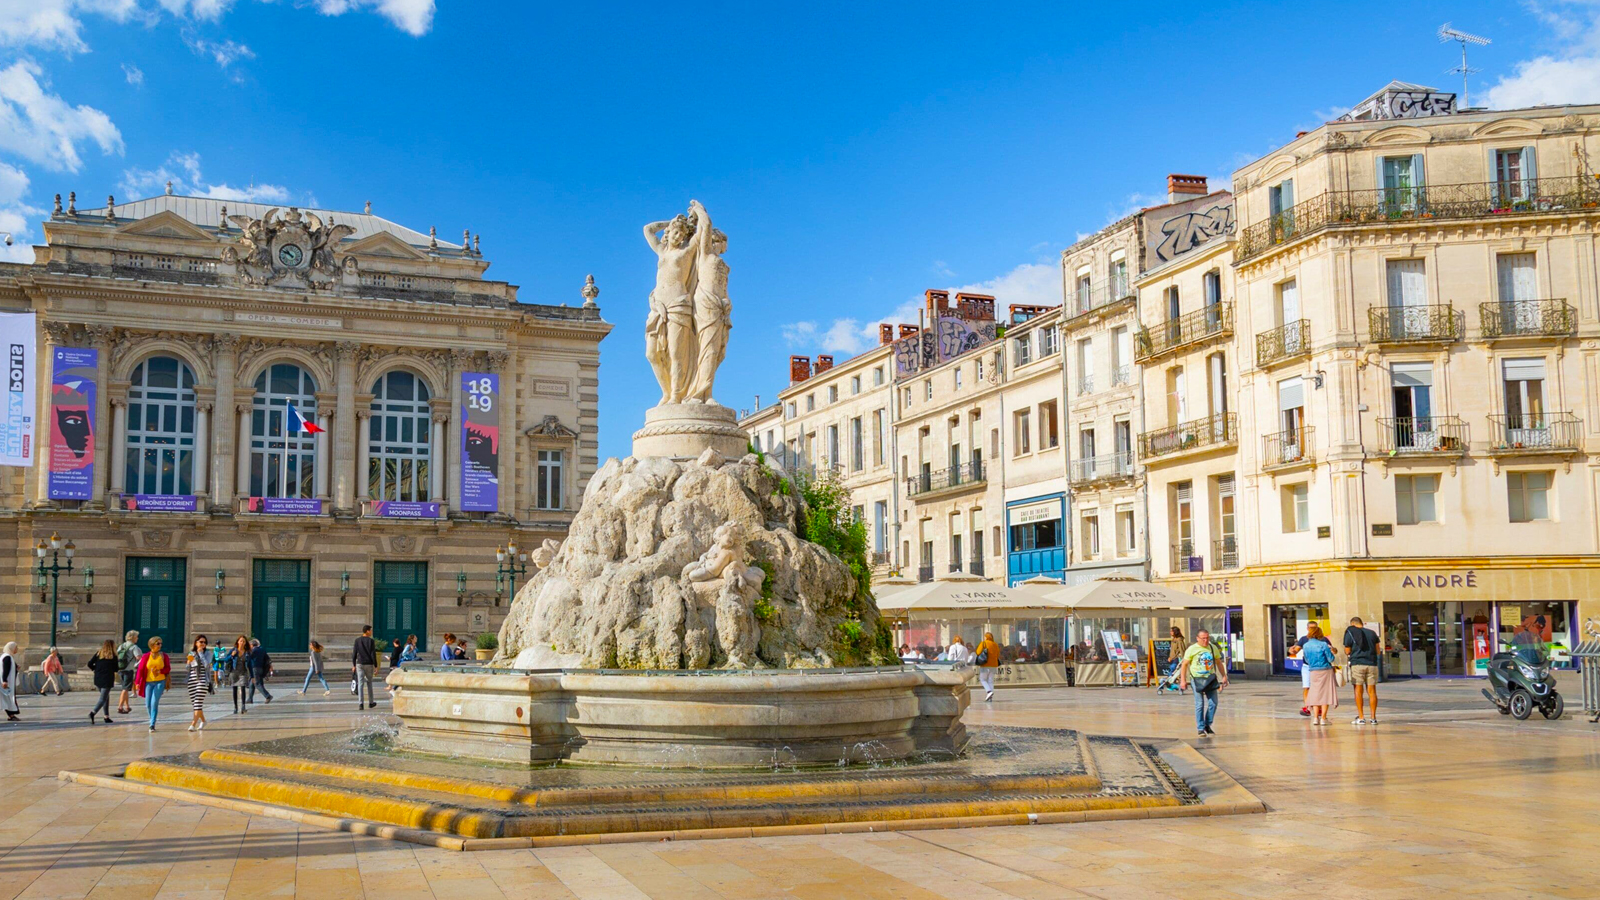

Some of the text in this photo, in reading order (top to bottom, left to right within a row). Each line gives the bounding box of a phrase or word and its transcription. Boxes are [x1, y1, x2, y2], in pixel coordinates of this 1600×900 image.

[248, 314, 330, 326] OPERA COMEDIE
[468, 377, 492, 394] 18
[468, 395, 492, 412] 19
[1192, 579, 1231, 595] ANDRÉ
[1271, 574, 1316, 591] ANDRÉ
[1402, 570, 1478, 588] ANDRÉ
